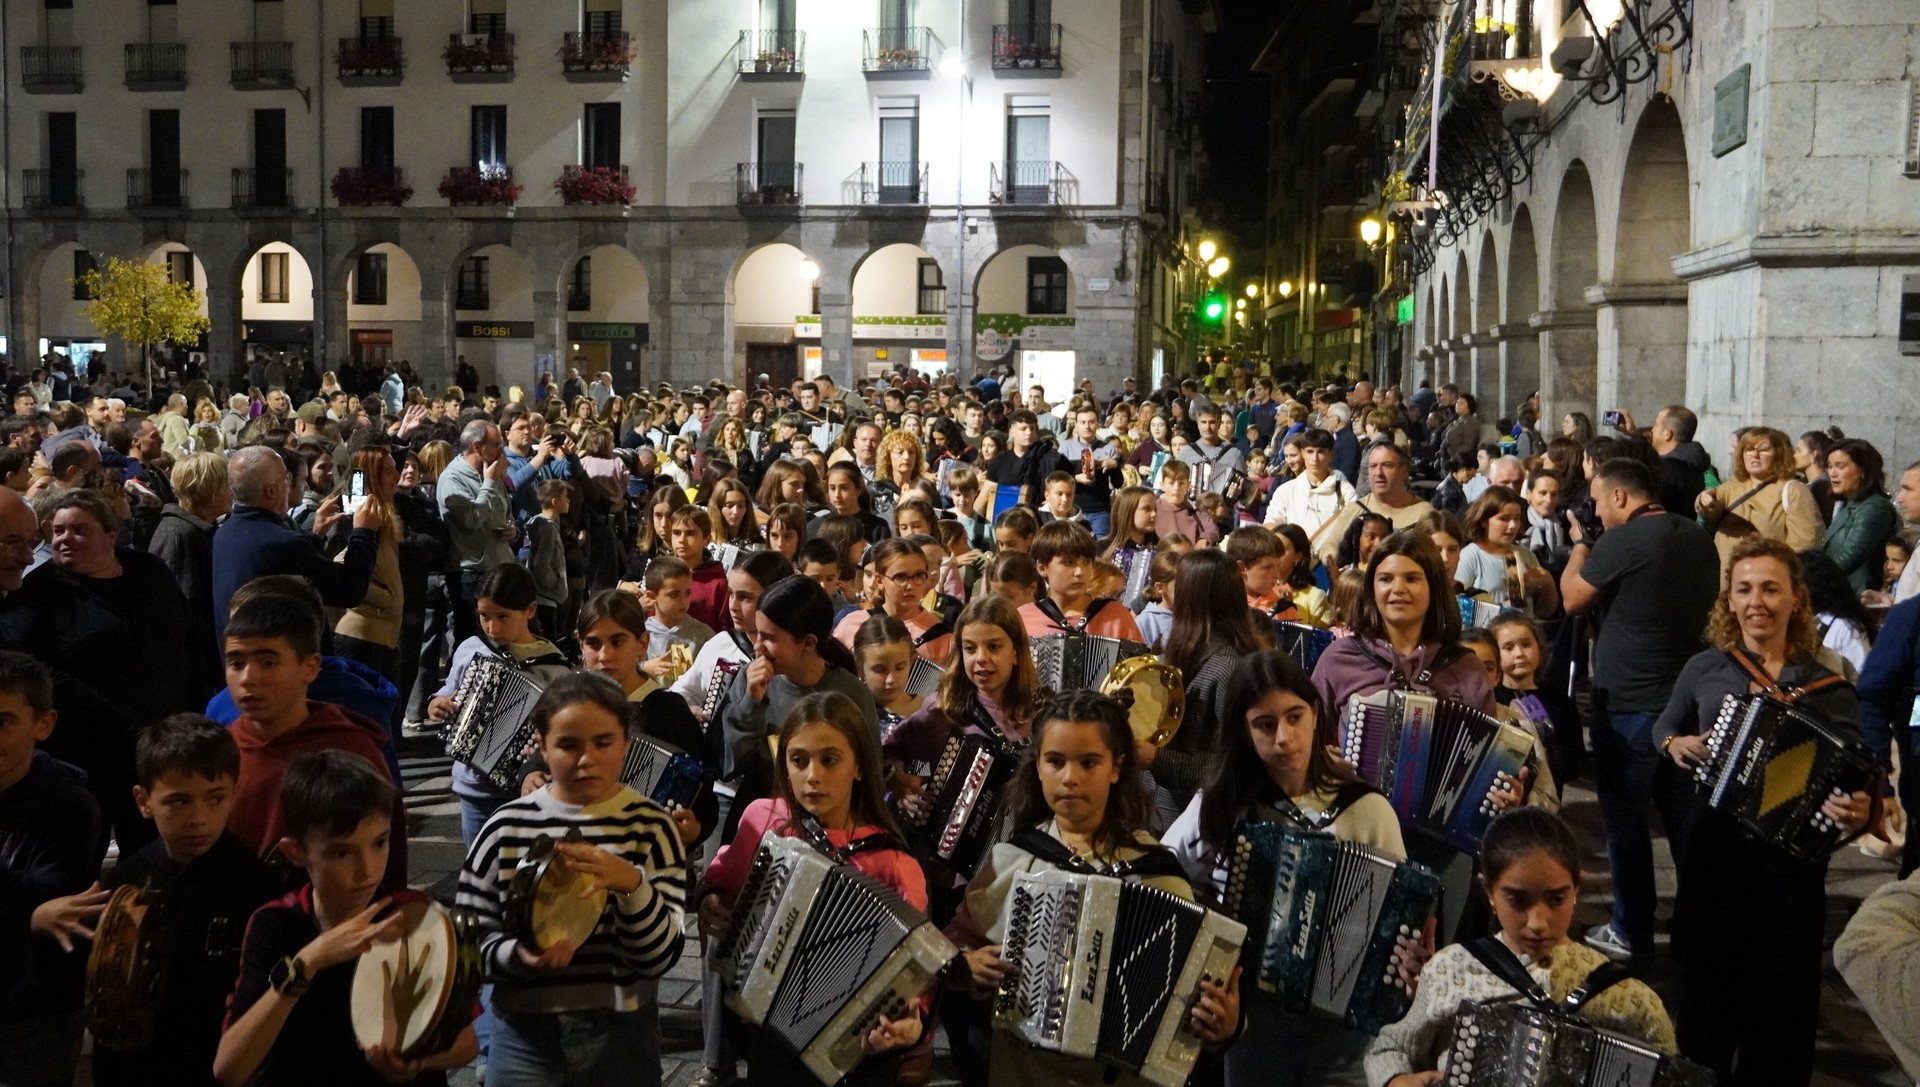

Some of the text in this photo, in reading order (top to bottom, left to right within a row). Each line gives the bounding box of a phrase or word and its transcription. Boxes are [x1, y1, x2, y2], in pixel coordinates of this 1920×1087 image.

[1747, 736, 1764, 761] Sette
[778, 906, 799, 940] Sette
[1299, 889, 1316, 925] Sette
[1087, 929, 1104, 967] Sette
